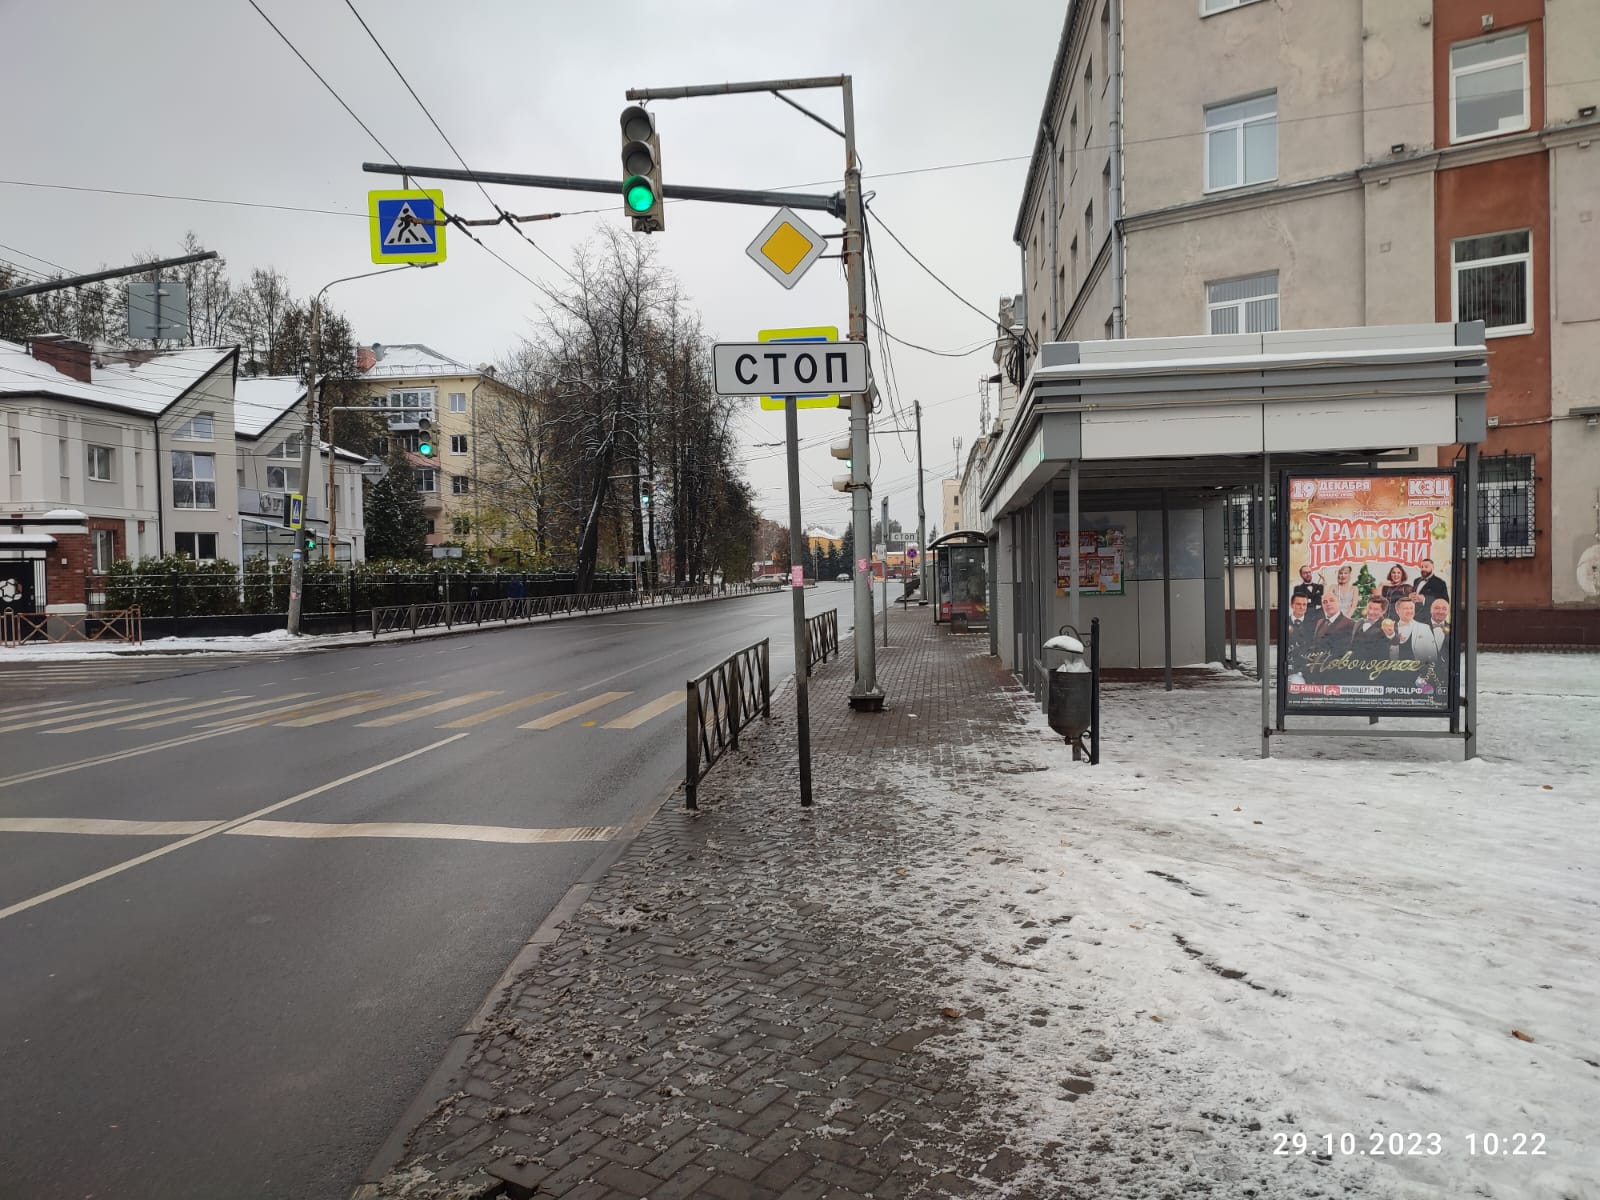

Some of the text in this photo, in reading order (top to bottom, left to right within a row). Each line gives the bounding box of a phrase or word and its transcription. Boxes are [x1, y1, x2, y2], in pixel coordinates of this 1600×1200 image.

[734, 352, 848, 385] СТОП
[1293, 481, 1315, 498] 19
[1319, 480, 1370, 490] ДЕКАБРЯ
[1409, 479, 1449, 496] КЗЦ
[1311, 517, 1431, 541] УРАЛЬСКИЕ
[1311, 540, 1431, 568] ПЕЛЬМЕНИ
